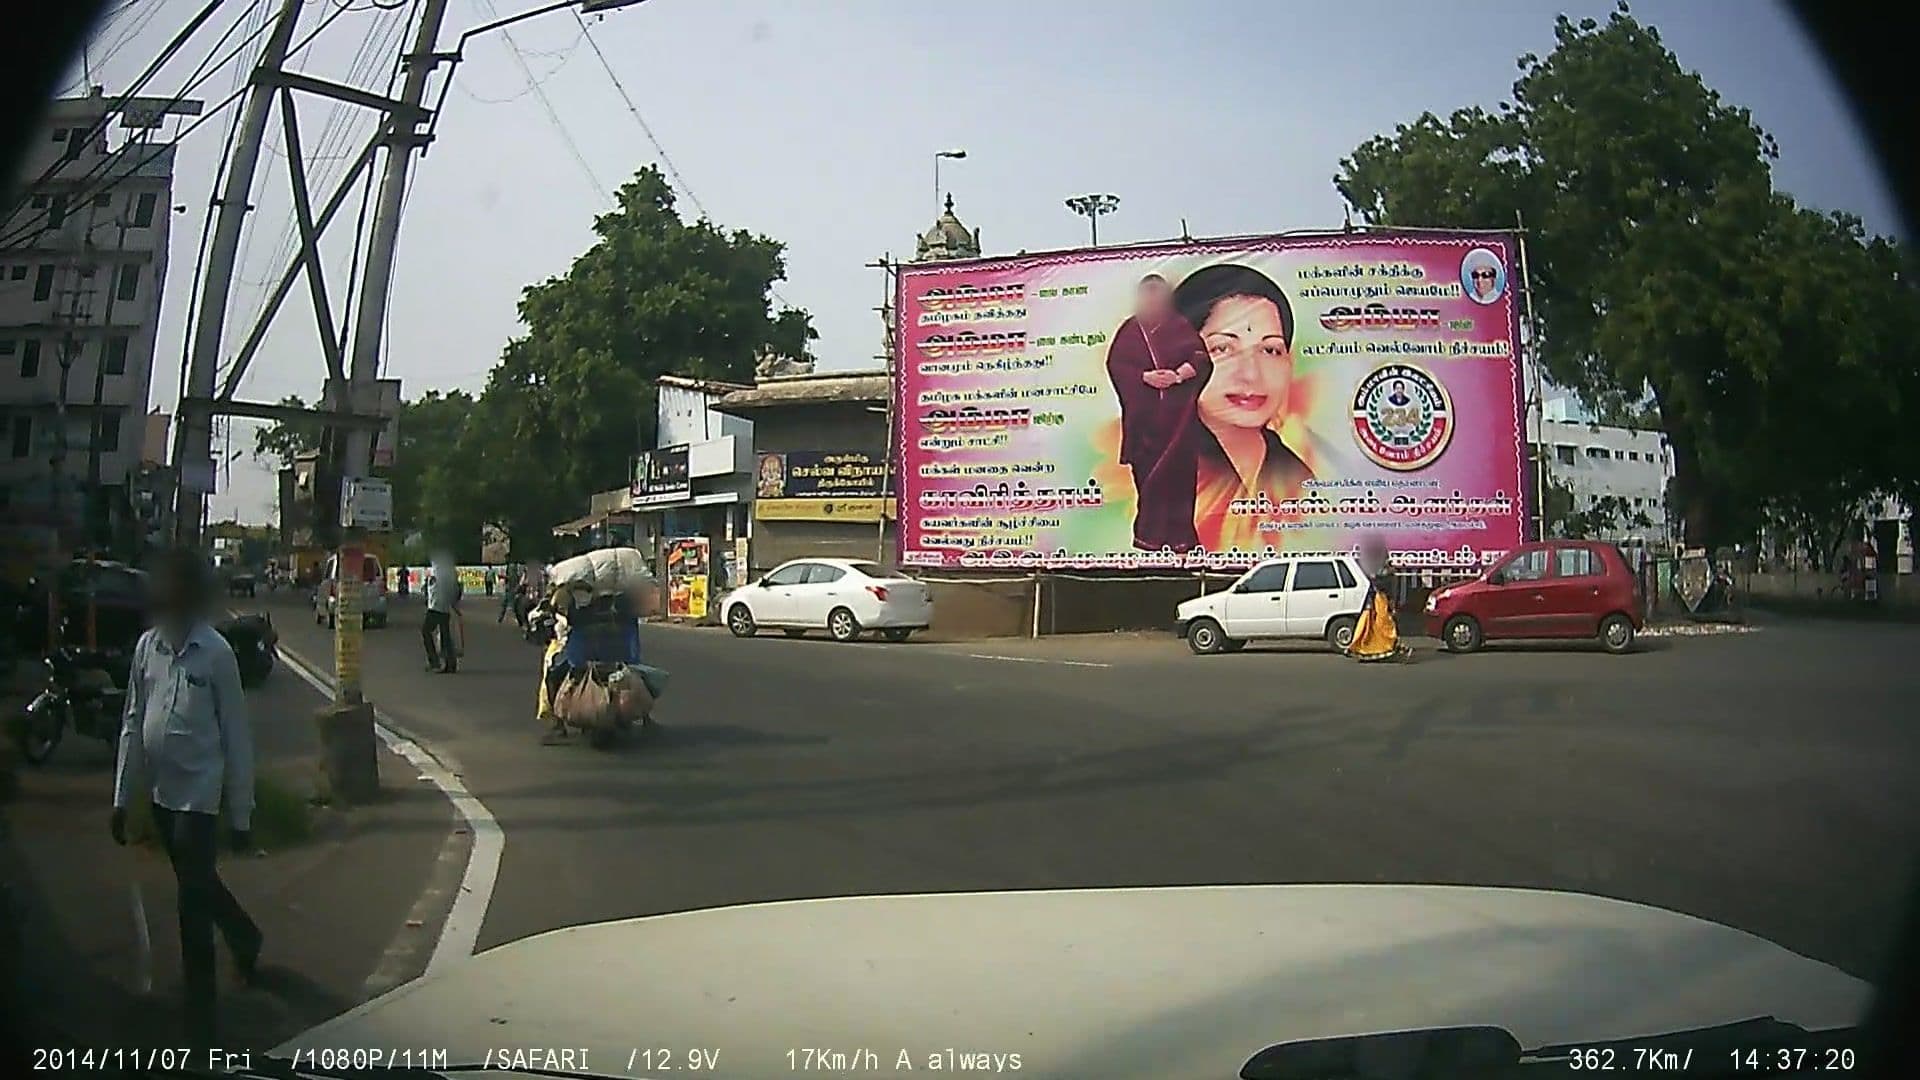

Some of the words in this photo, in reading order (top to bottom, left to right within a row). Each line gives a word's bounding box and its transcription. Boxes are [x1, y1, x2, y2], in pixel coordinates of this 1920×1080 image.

[1298, 265, 1364, 280] மக்களின்
[1367, 263, 1424, 279] சக்திக்கு
[917, 284, 1025, 311] அம்மா
[1299, 284, 1391, 300] எப்பொழுதும்
[1395, 284, 1460, 297] ஜெயமே!!
[920, 311, 970, 325] தமிழகம்
[974, 308, 1027, 321] தவித்தது
[1320, 303, 1441, 331] அம்மா
[917, 331, 1026, 358] அம்மா
[1303, 342, 1361, 355] லட்சியம்
[1366, 341, 1446, 355] வெல்வோம்
[1449, 341, 1508, 356] நிச்சயம்!
[920, 360, 971, 374] வானமும்
[920, 391, 961, 404] தமிழக
[964, 390, 1018, 401] மக்களின்
[1021, 384, 1097, 398] மனசாட்சியே
[919, 406, 1031, 433] அம்மா
[920, 436, 964, 449] என்றும்
[968, 434, 1008, 447] சாட்சி!!
[791, 463, 835, 477] செல்வ
[920, 464, 961, 476] மக்கள்
[964, 464, 1008, 475] மனதை
[1012, 462, 1055, 474] வென்ற
[920, 478, 1102, 511] காவிரித்தாய்
[921, 516, 994, 528] கயவர்களின்
[998, 516, 1060, 530] சூழ்ச்சியை
[922, 536, 975, 548] வெல்வது
[979, 535, 1034, 547] நிச்சயம்!!
